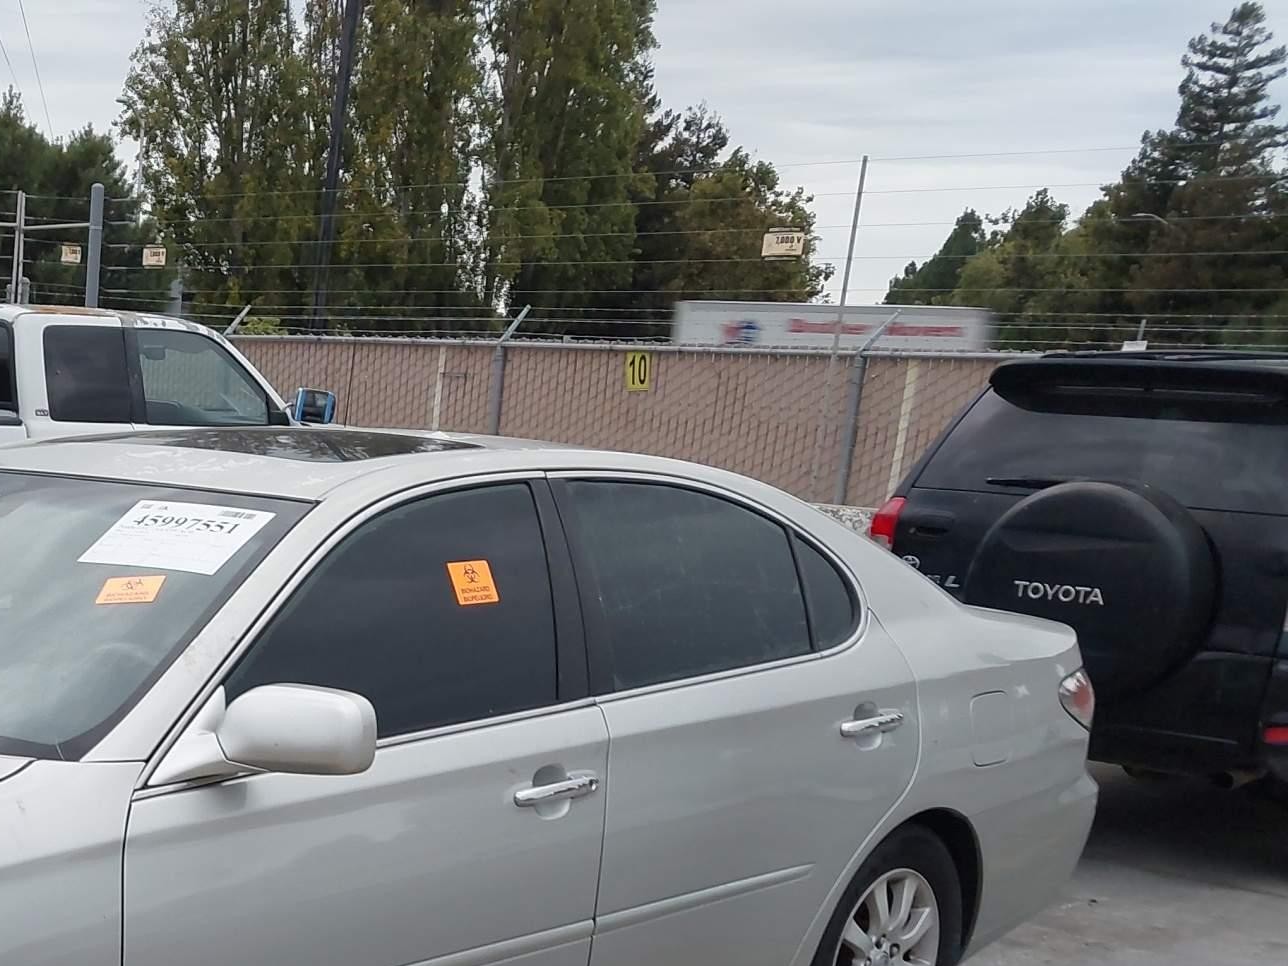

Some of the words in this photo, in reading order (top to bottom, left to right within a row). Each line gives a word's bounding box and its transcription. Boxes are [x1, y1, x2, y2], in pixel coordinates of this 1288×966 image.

[629, 354, 647, 386] 10
[132, 513, 241, 534] 45997551
[1013, 580, 1105, 606] TOYOTA
